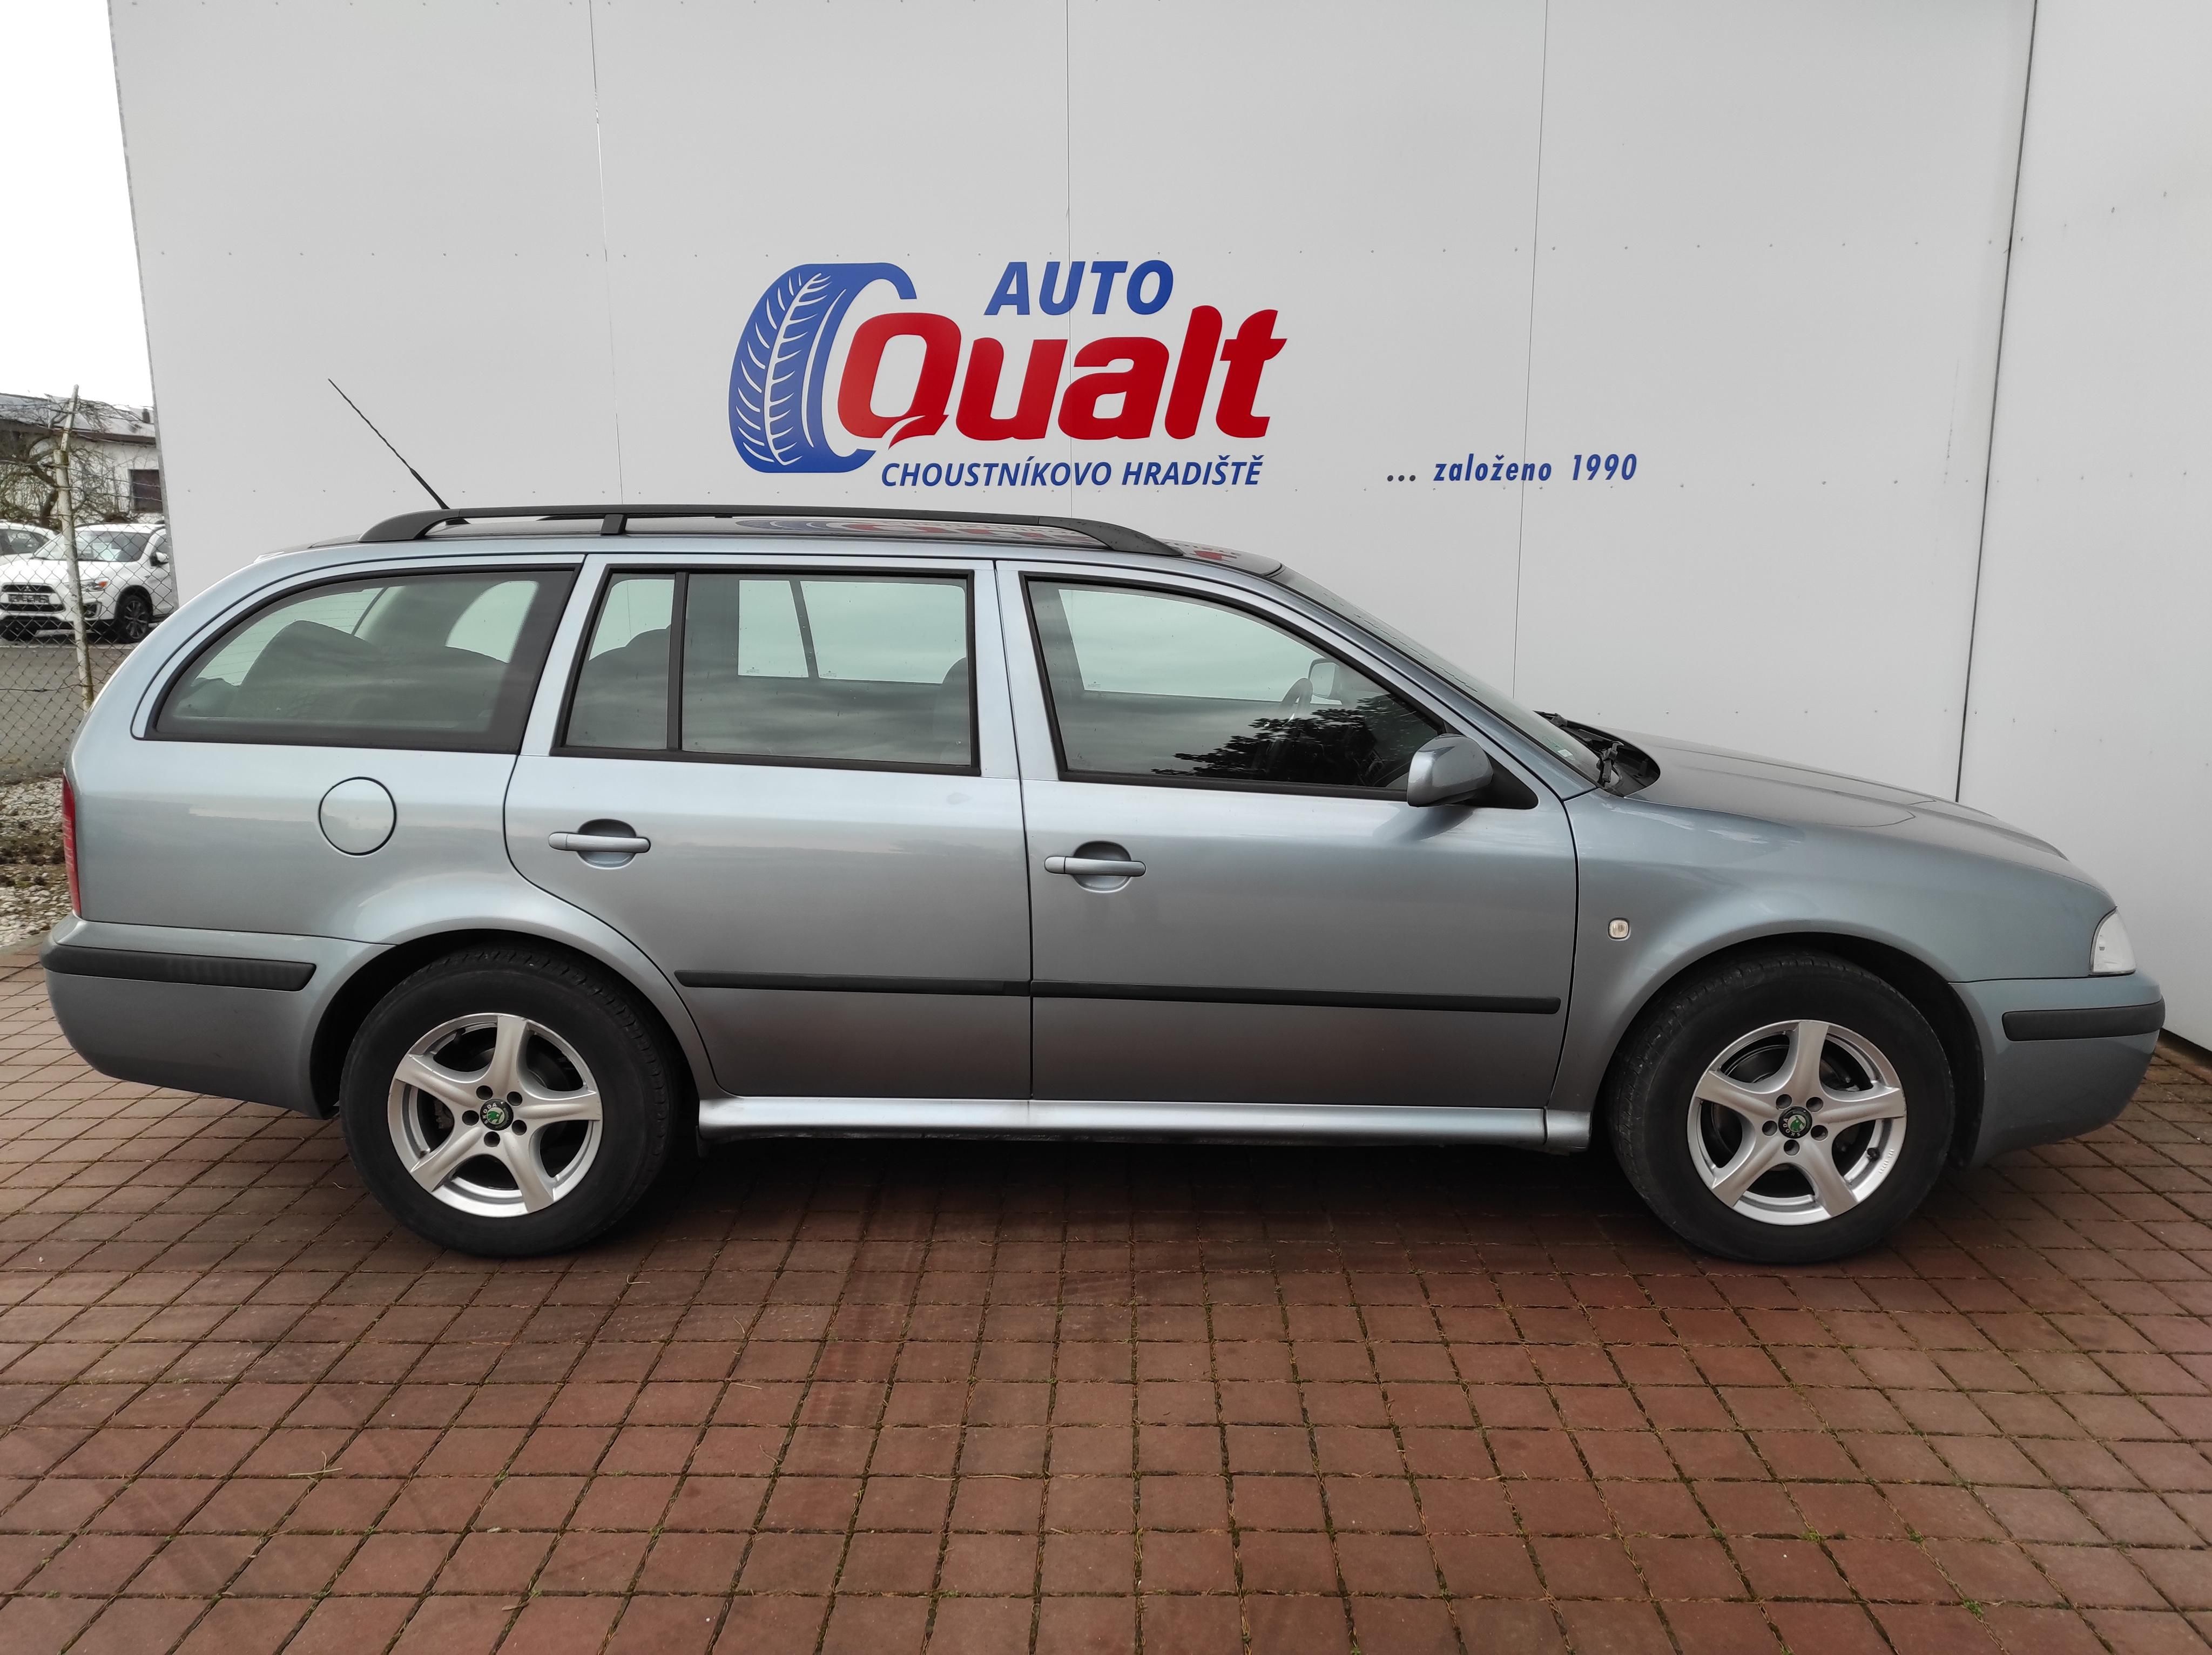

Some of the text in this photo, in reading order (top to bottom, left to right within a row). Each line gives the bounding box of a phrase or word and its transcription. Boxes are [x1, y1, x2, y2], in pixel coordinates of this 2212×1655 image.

[984, 259, 1174, 316] AUTO
[838, 305, 1287, 449] Qualt
[881, 455, 1264, 487] CHOUSTNÍKOVO HRADIŠTĚ
[1433, 453, 1552, 482] založeno
[1572, 453, 1637, 481] 1990
